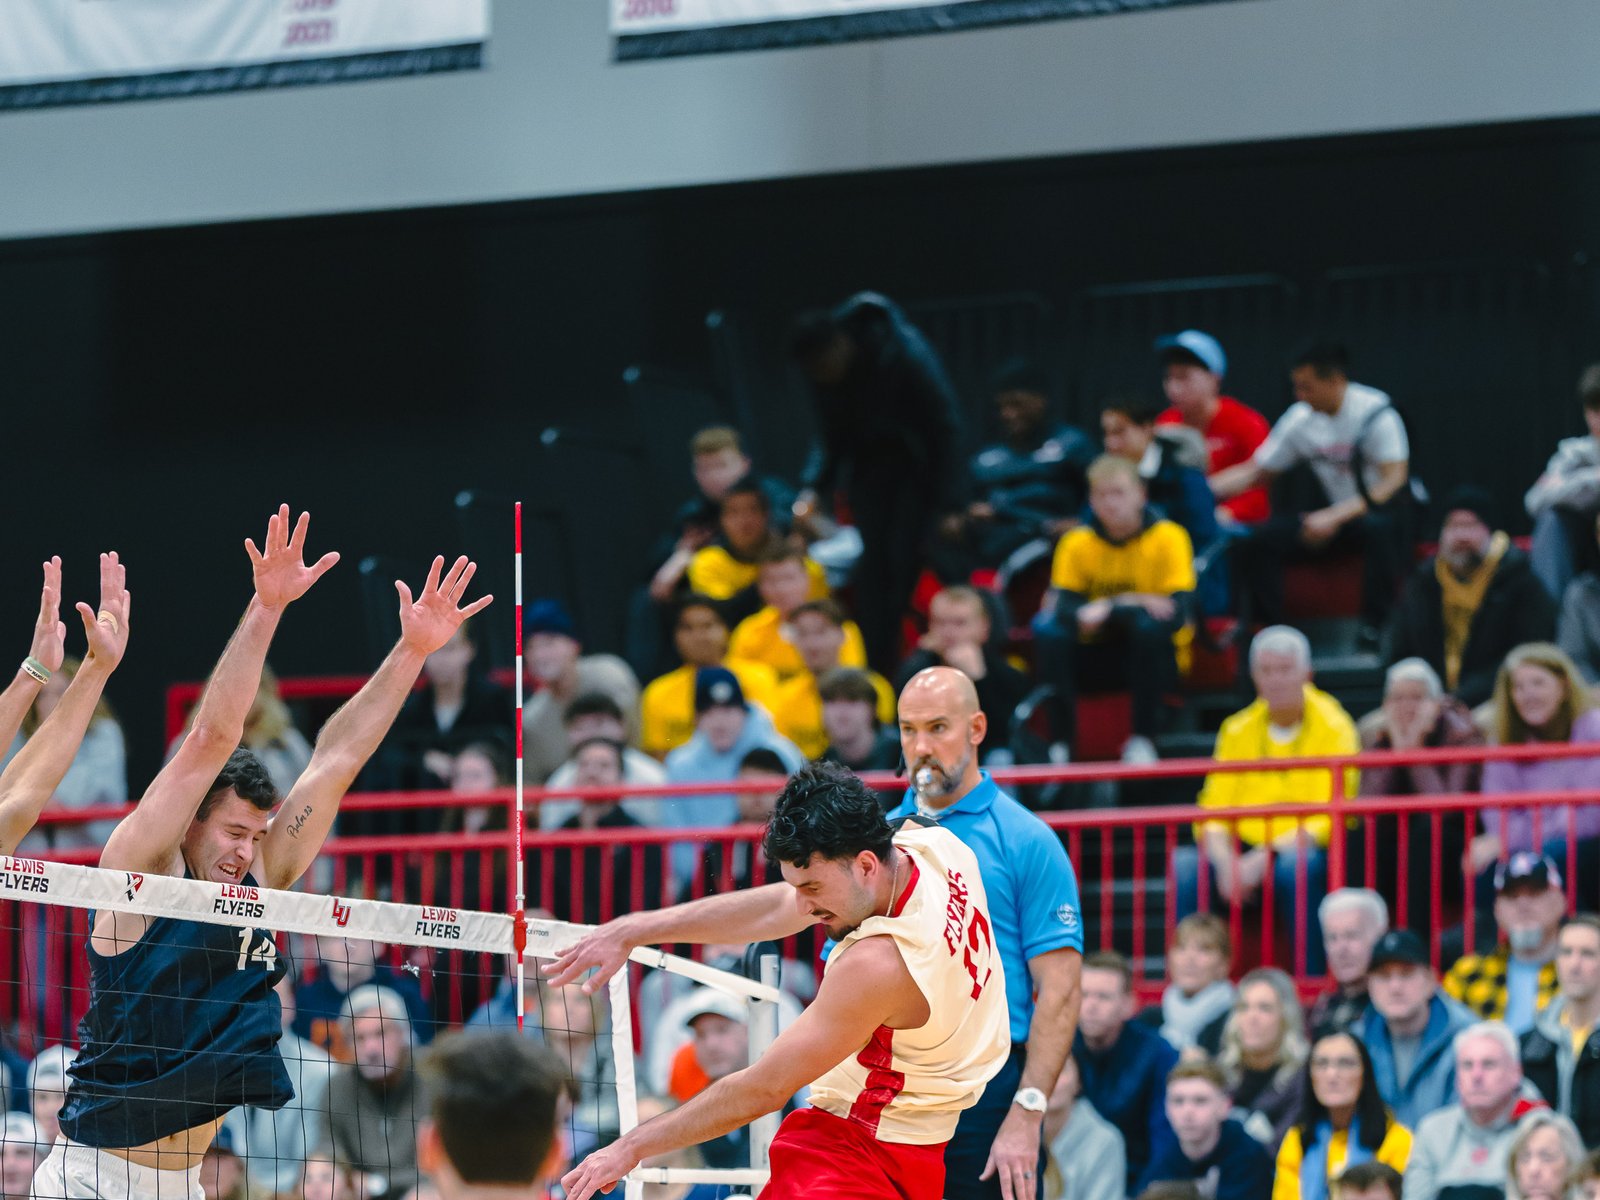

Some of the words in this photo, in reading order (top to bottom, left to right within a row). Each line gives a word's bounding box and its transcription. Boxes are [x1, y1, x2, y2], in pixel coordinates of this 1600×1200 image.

[4, 857, 45, 875] LEWIS
[221, 884, 259, 900] LEWIS
[213, 898, 265, 918] FLYERS
[331, 898, 351, 927] LU
[421, 907, 457, 922] LEWIS
[943, 868, 969, 957] FLYERS
[414, 921, 461, 940] FLYERS
[235, 926, 278, 971] 14
